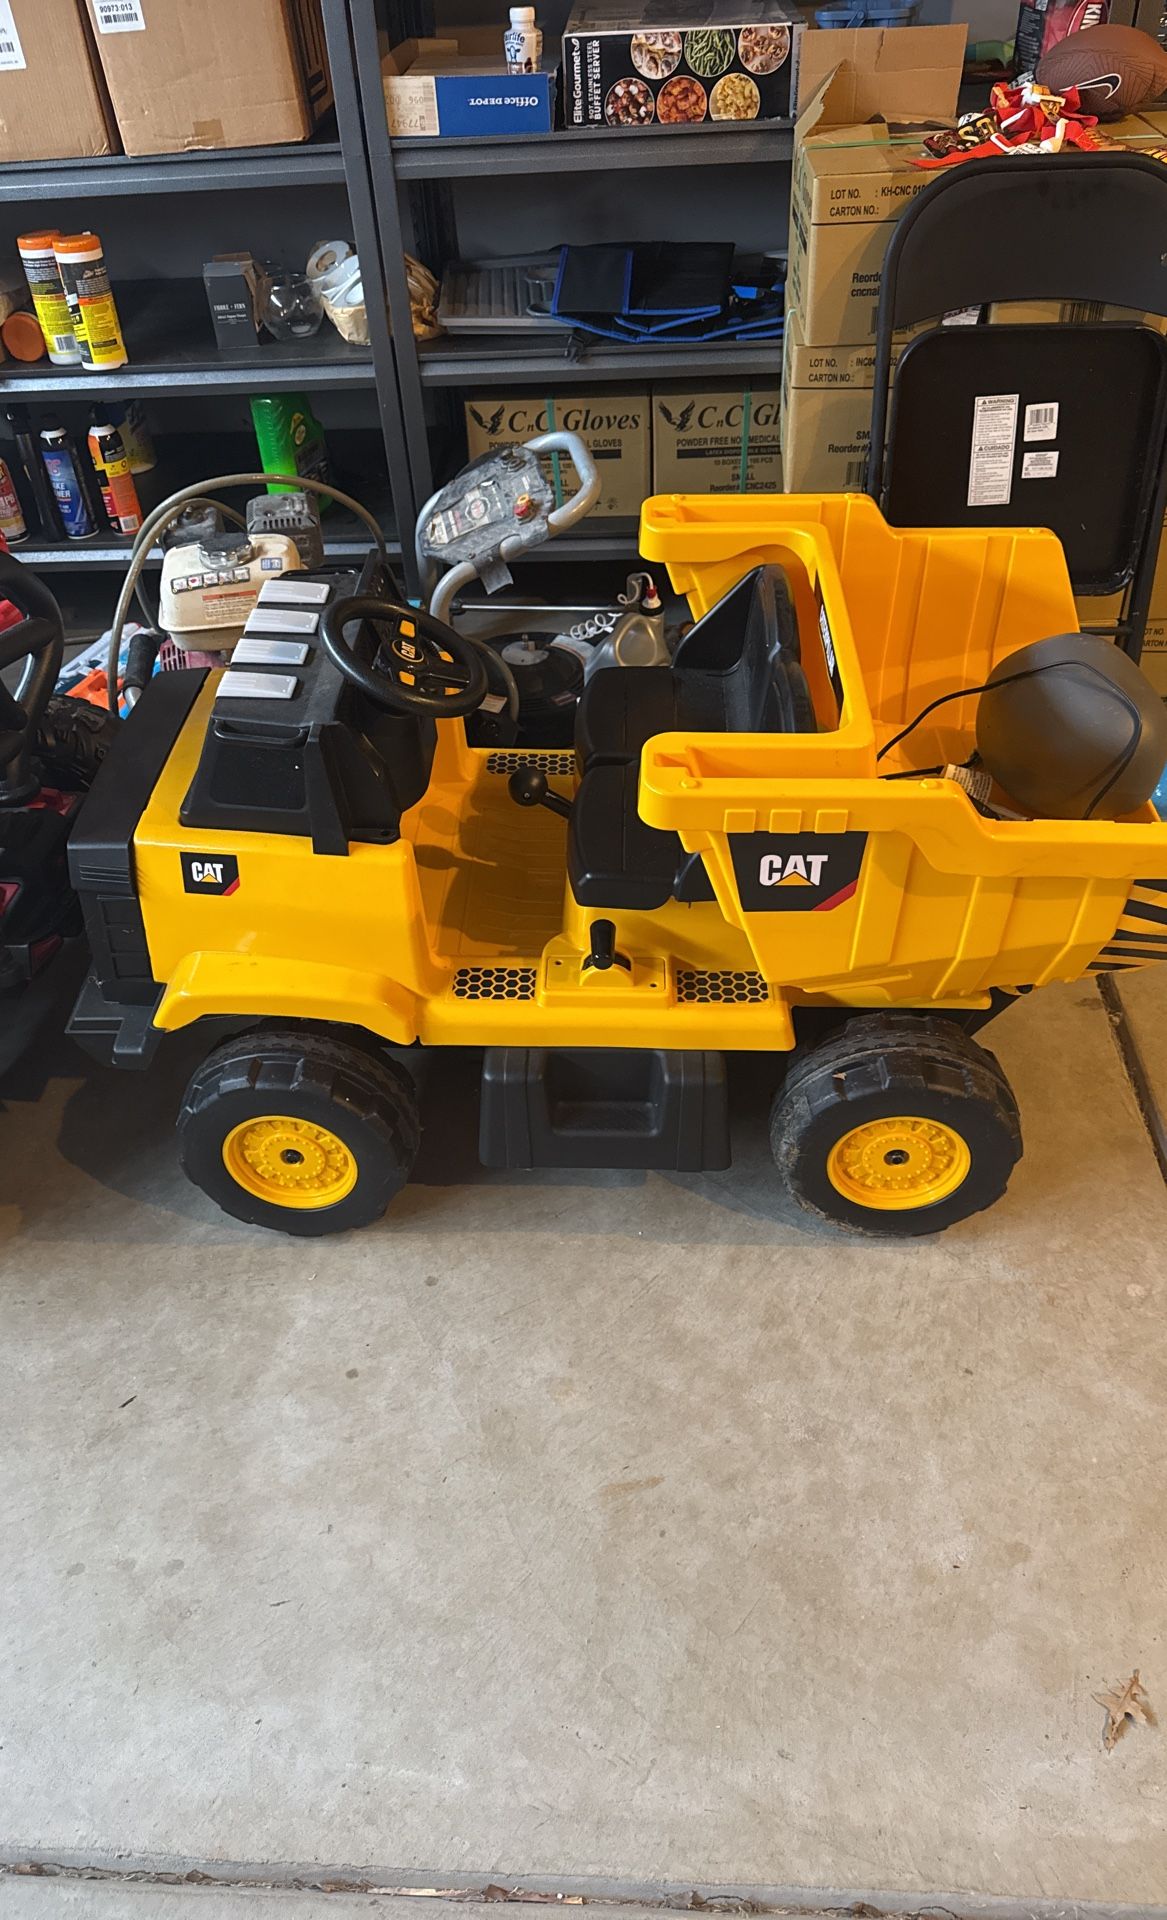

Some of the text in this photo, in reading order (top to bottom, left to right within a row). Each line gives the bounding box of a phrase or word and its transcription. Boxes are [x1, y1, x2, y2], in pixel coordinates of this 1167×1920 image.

[586, 41, 594, 62] STEEL
[587, 64, 595, 102] STAINLESS
[592, 39, 602, 120] BUFFET SERVER
[503, 96, 539, 107] Office
[830, 189, 846, 200] LOT
[847, 188, 861, 199] NO.
[880, 185, 911, 197] KH-CNC
[829, 205, 862, 217] CARTON
[809, 358, 824, 368] LOT
[825, 358, 838, 368] NO.
[808, 373, 838, 383] CARTON
[562, 408, 641, 432] Gloves
[593, 439, 623, 448] GLOVES
[676, 438, 709, 447] POWDER
[709, 437, 729, 445] FREE
[983, 444, 1010, 452] CUIDADO
[400, 640, 416, 659] CAT
[191, 861, 224, 884] CAT
[758, 854, 829, 886] CAT
